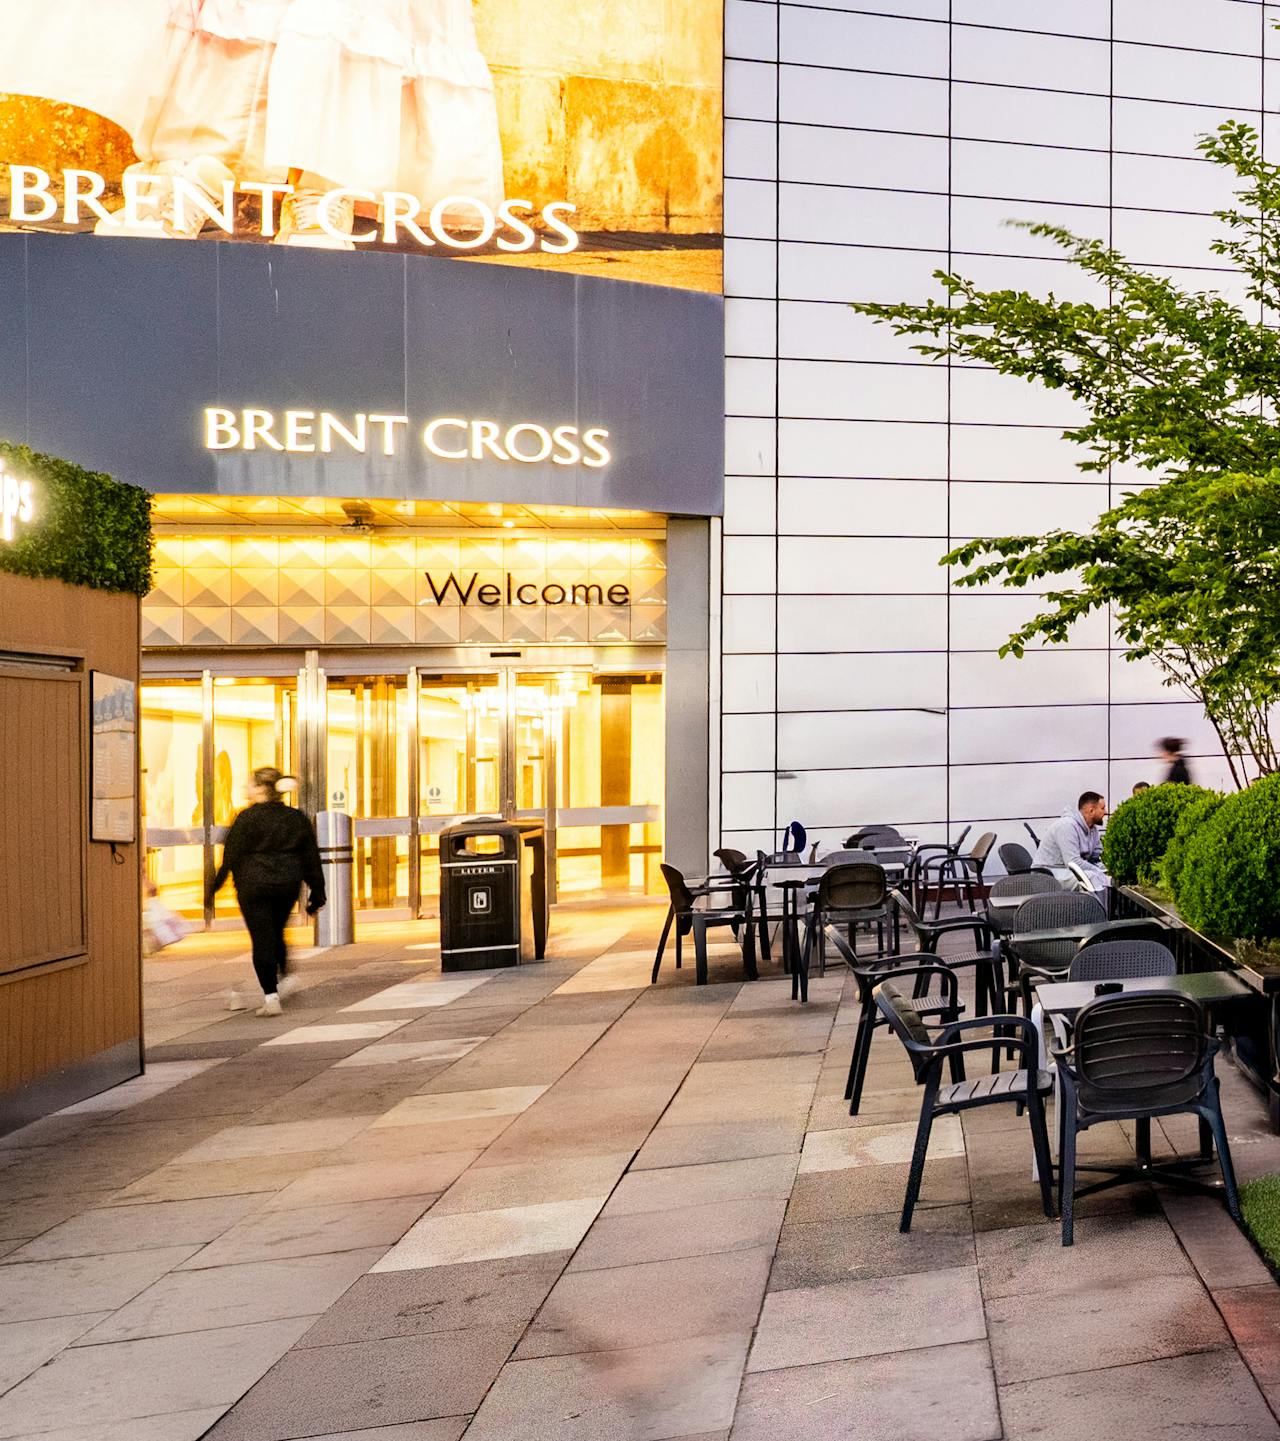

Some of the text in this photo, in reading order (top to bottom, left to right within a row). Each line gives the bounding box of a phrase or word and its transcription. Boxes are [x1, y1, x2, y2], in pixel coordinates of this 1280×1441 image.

[7, 163, 580, 254] BRENT CROSS
[204, 407, 611, 468] BRENT CROSS
[425, 571, 630, 606] Welcome
